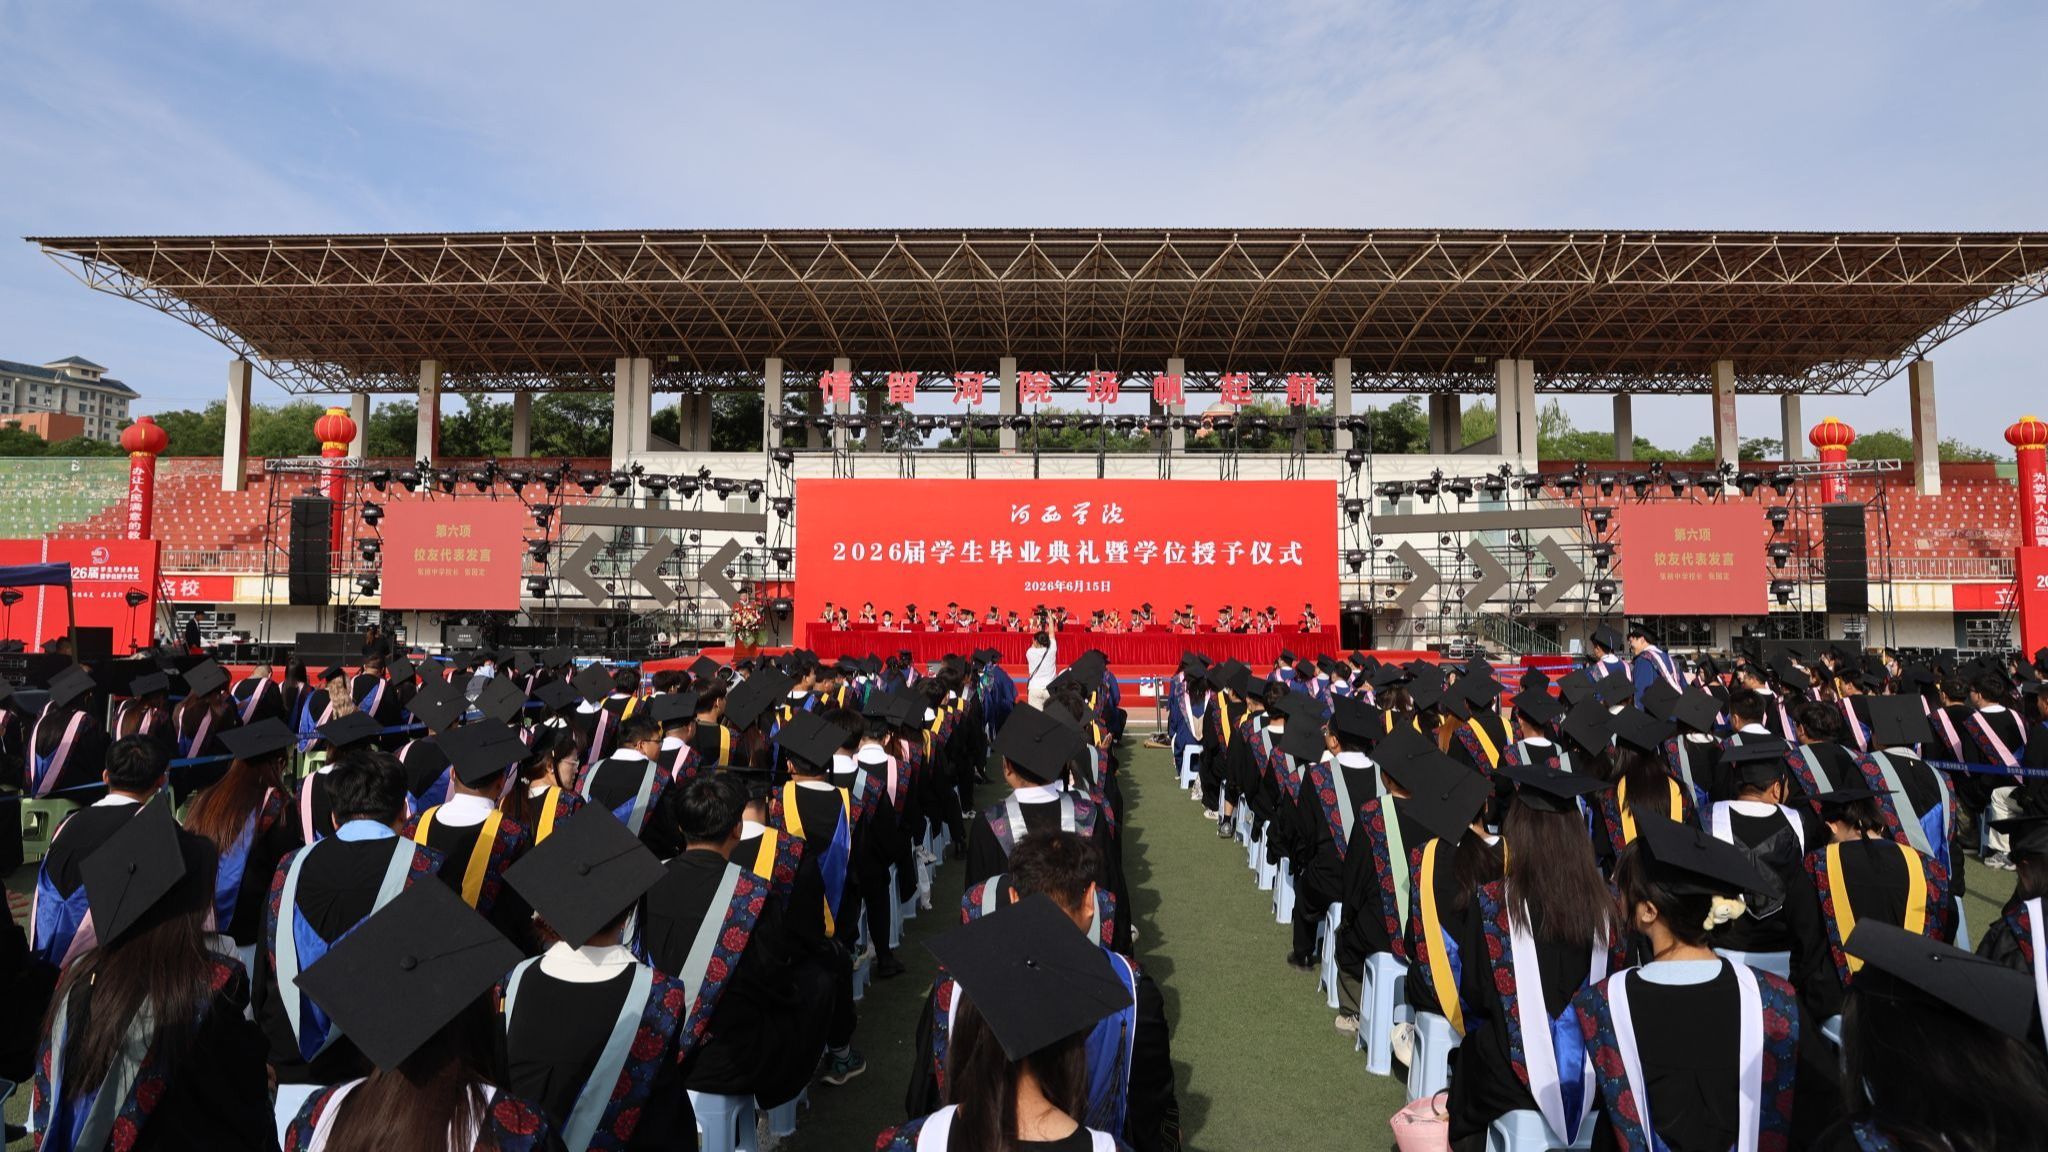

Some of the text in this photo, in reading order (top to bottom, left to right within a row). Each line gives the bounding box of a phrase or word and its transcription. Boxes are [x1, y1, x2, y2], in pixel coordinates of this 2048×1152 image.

[819, 369, 1319, 406] 情留河院扬帆起航
[1010, 501, 1125, 525] 河西学院
[435, 524, 471, 538] 第六项
[1674, 527, 1711, 541] 第六项
[414, 548, 491, 562] 校友代表发言
[833, 540, 1303, 566] 2026届学生毕业典礼暨学位授予仪式
[1654, 552, 1734, 566] 校友代表发言
[71, 566, 99, 580] 26届
[1024, 579, 1111, 593] 2026年6月15日
